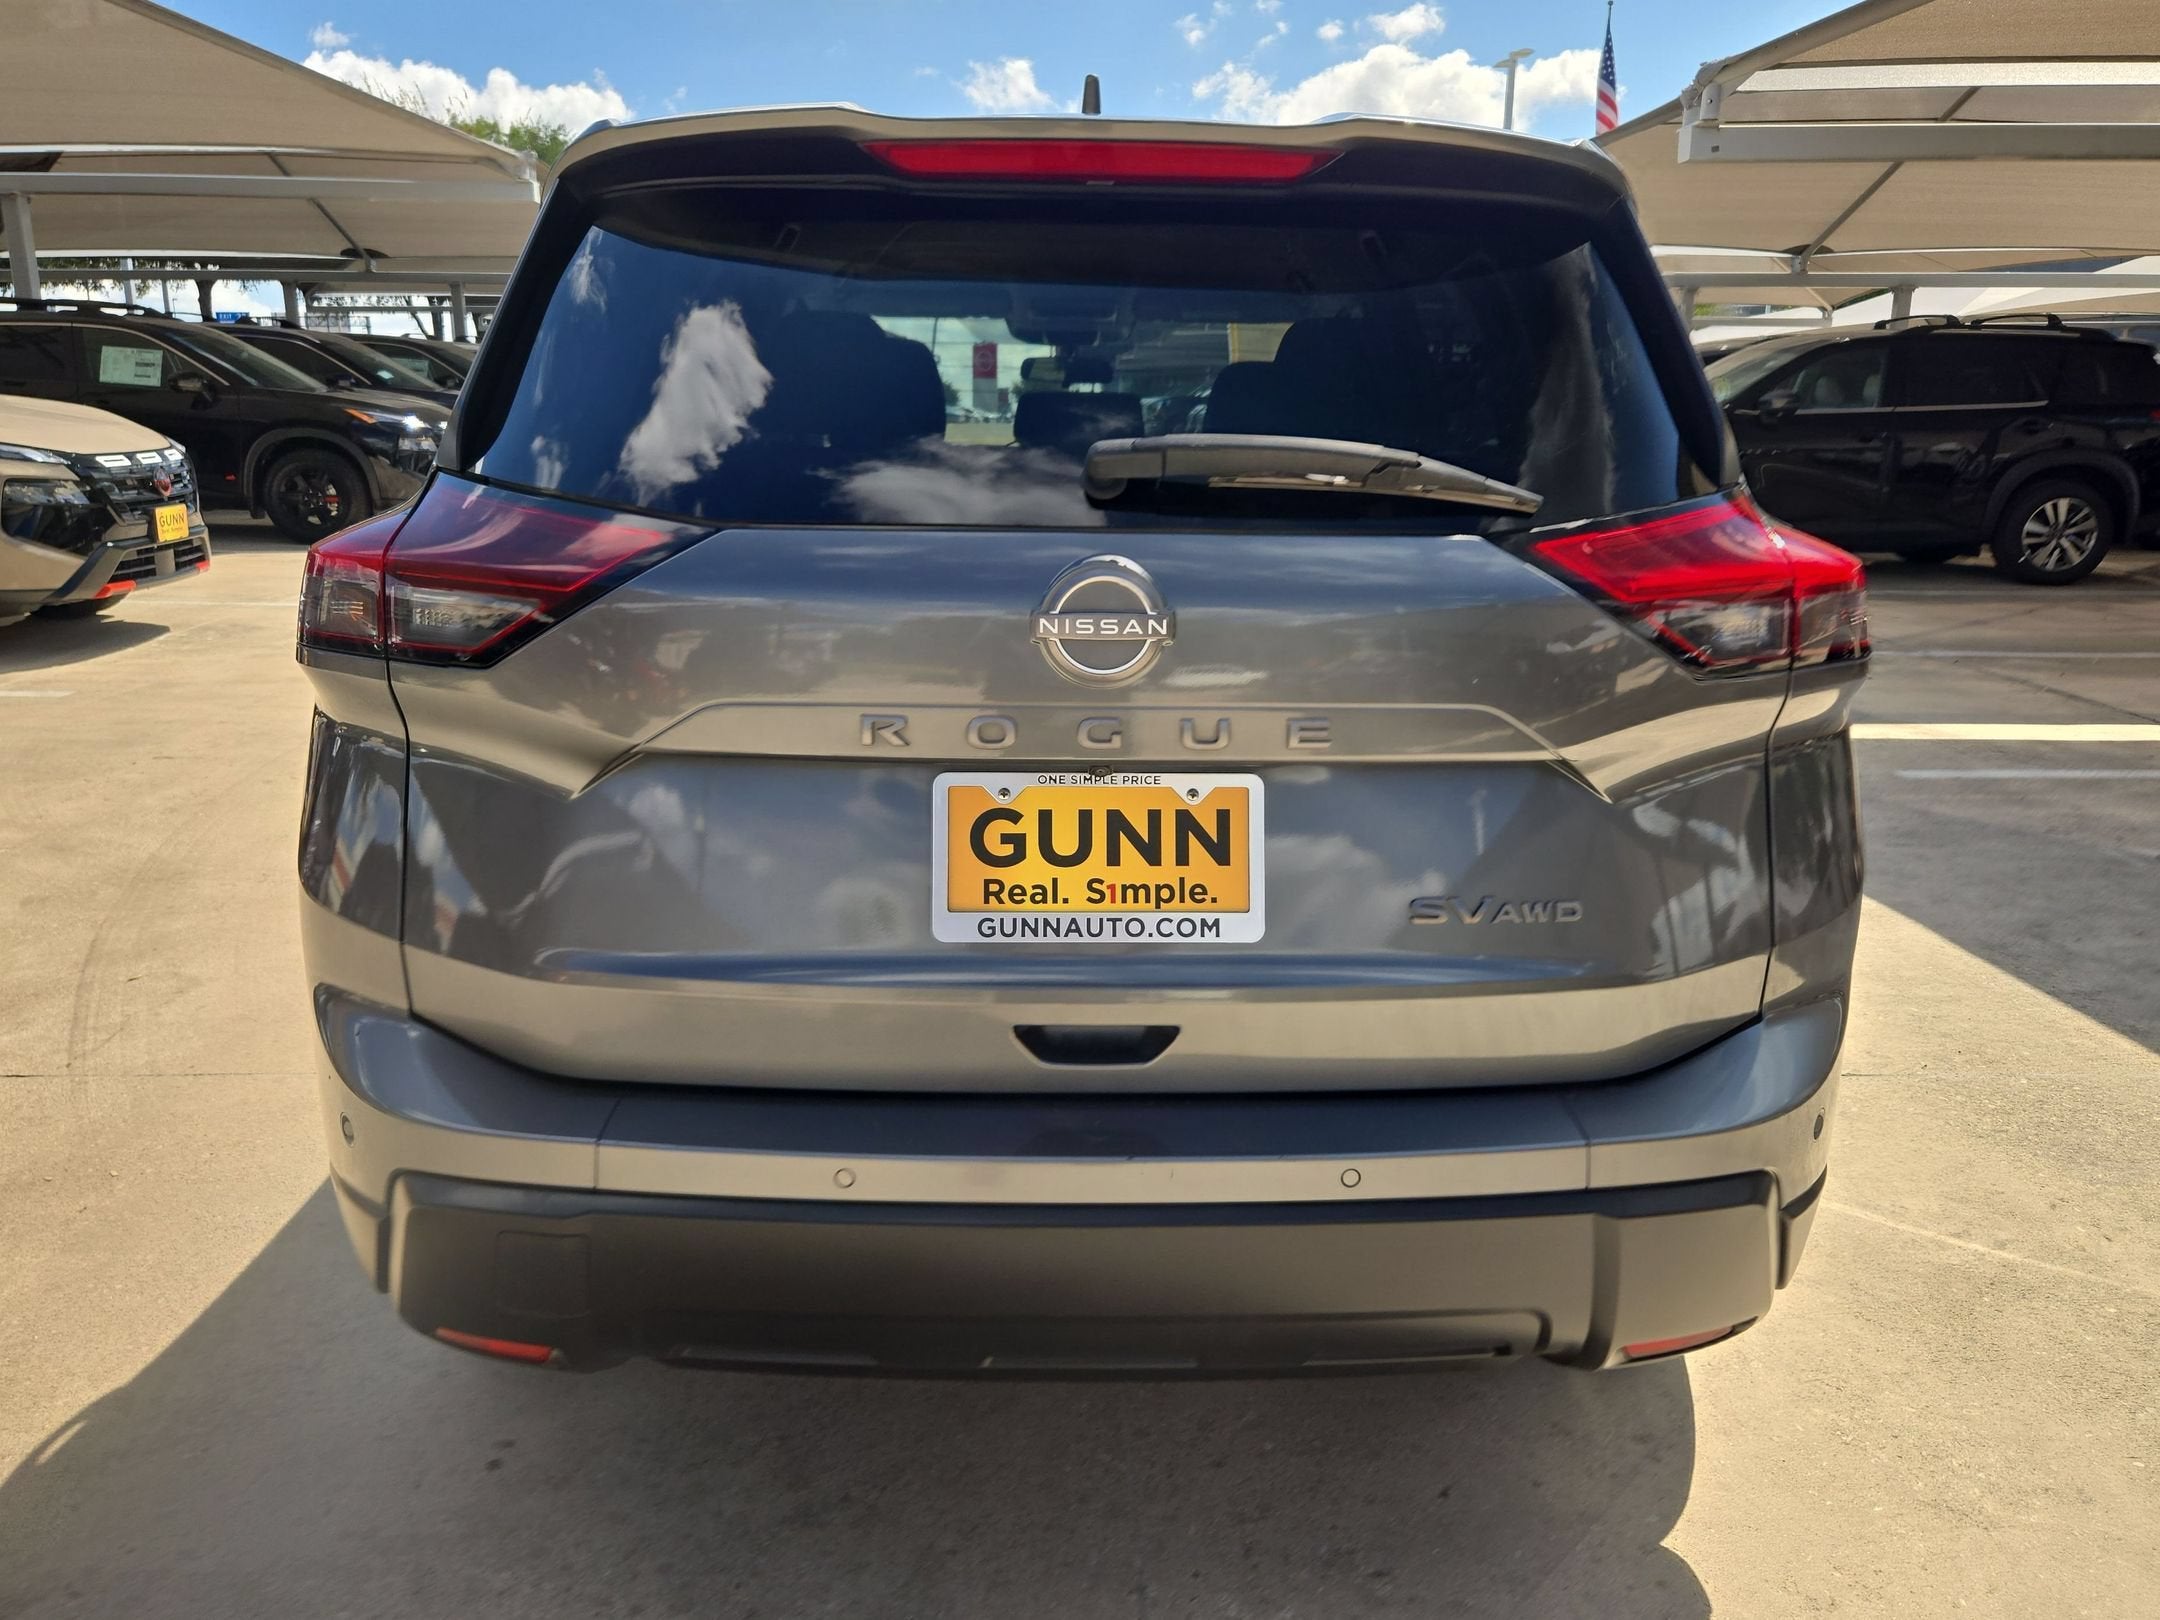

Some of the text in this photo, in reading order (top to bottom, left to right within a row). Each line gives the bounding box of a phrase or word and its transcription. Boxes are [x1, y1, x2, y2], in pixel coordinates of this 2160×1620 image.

[159, 513, 185, 528] GUNN
[1039, 616, 1168, 636] NISSAN
[860, 713, 1333, 750] ROGUE
[1037, 774, 1162, 785] ONE SIMPLE PRICE
[969, 807, 1231, 868] GUNN
[983, 877, 1069, 905] Real.
[977, 917, 1221, 938] GUNNAUTO.COM
